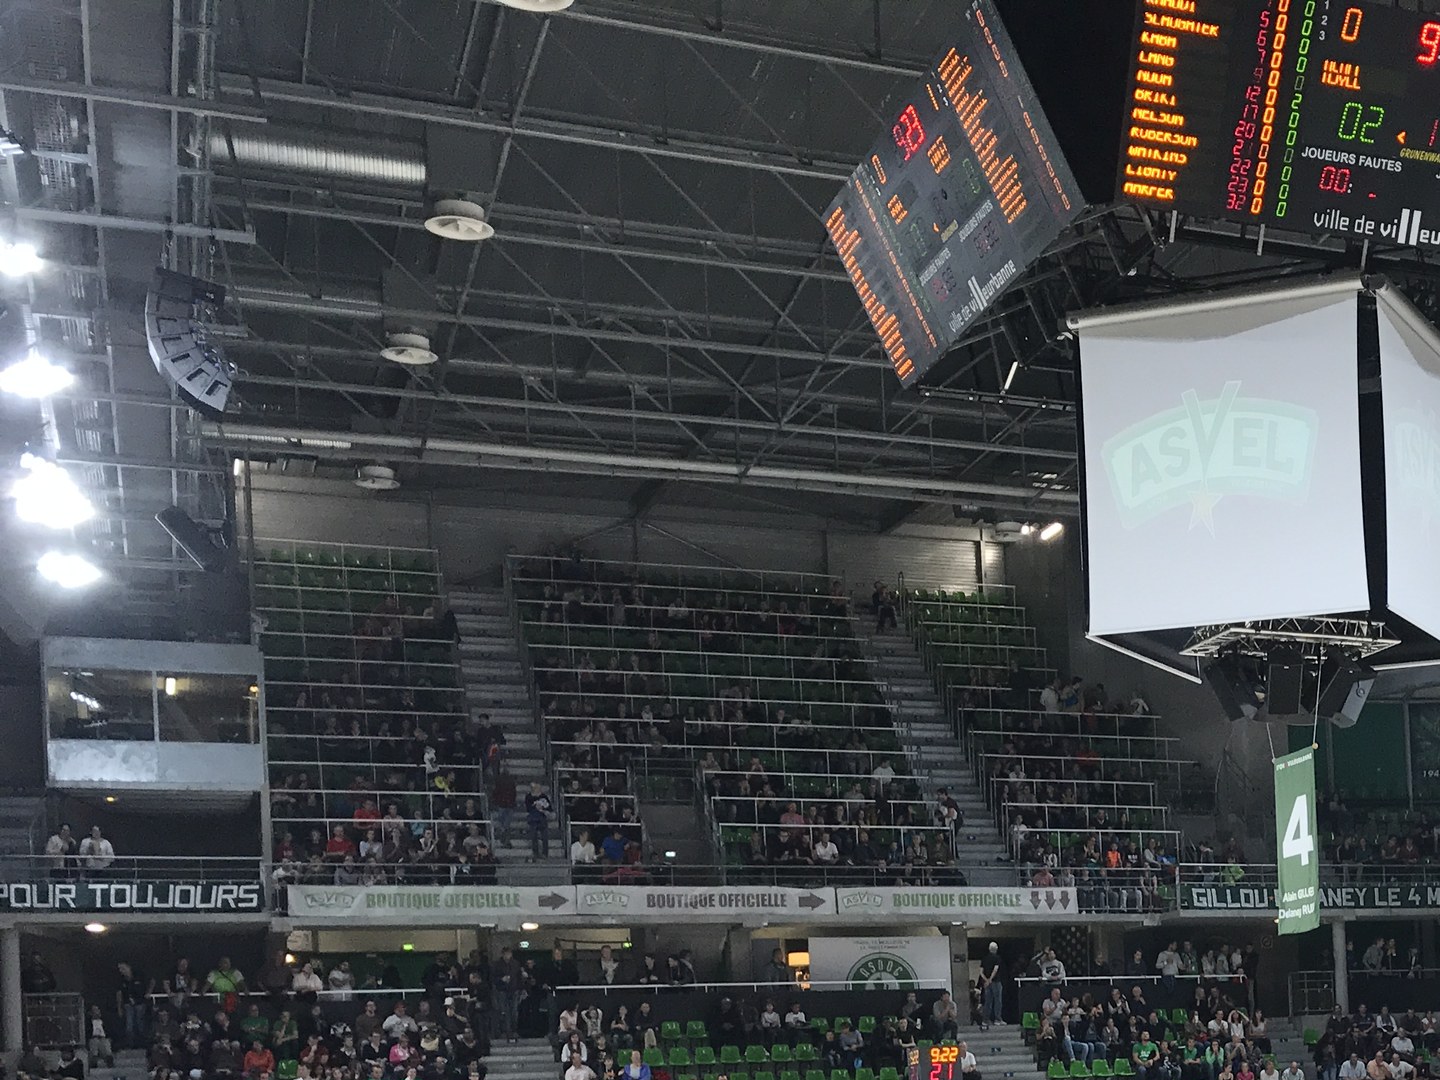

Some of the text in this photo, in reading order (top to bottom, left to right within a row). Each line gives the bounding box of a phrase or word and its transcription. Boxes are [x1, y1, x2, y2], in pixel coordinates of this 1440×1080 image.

[1260, 10, 1270, 28] 5
[1340, 8, 1362, 41] 0
[1257, 30, 1266, 47] 6
[1234, 120, 1256, 138] 20
[1338, 101, 1384, 144] 02
[1230, 158, 1251, 175] 22
[1302, 146, 1402, 172] JOUEURS FAUTES
[1314, 209, 1350, 231] ville
[1354, 215, 1374, 235] de
[969, 260, 1016, 312] villeurbanne
[1130, 380, 1294, 499] ASVEL
[1282, 794, 1314, 866] 4
[88, 884, 260, 908] TOUJOURS
[366, 892, 520, 908] BOUTIQUE OFFICIELLE
[646, 892, 787, 909] BOUTIQUE OFFICIELLE
[893, 892, 1022, 908] BOUTIQUE OFFICIELLE
[1192, 887, 1268, 908] GILLOU
[1375, 887, 1401, 907] LE
[1409, 886, 1421, 904] 4
[930, 1046, 958, 1062] 9:22
